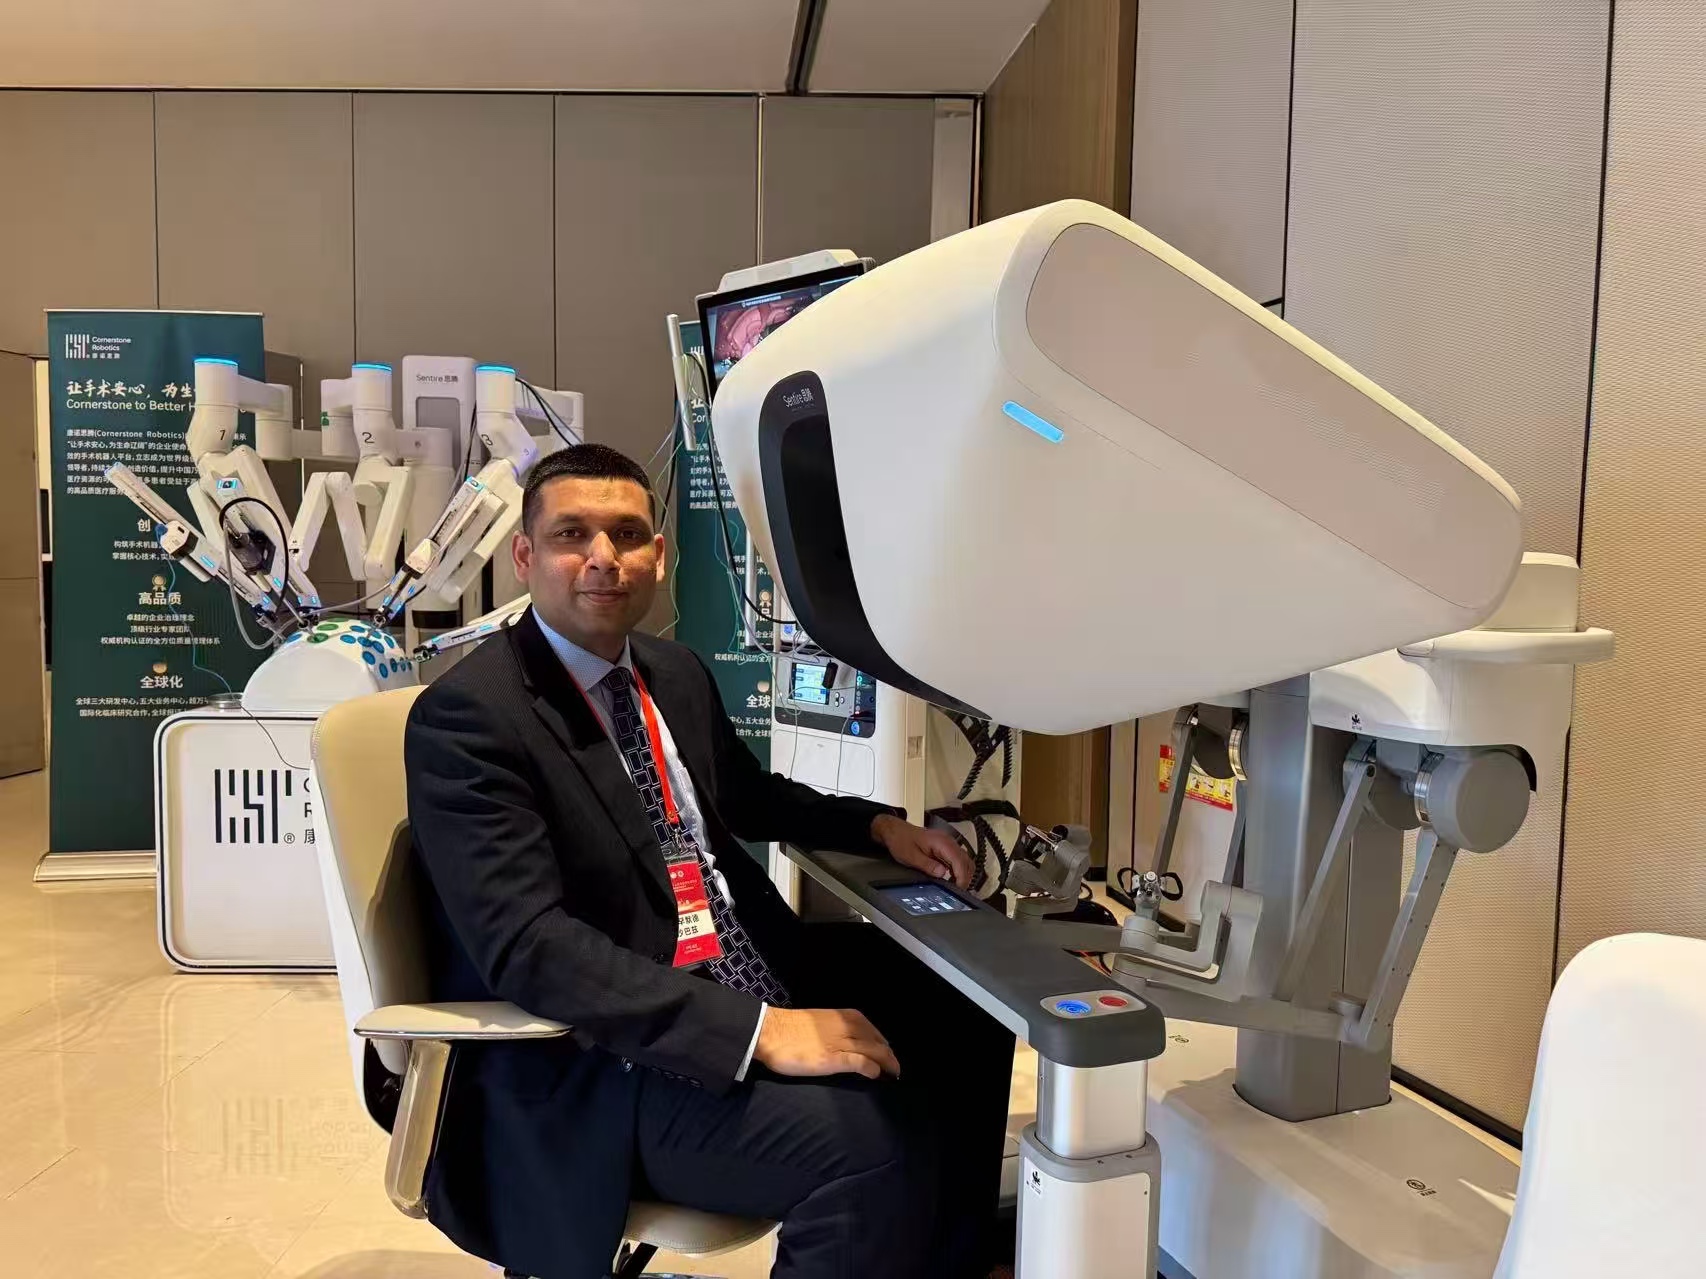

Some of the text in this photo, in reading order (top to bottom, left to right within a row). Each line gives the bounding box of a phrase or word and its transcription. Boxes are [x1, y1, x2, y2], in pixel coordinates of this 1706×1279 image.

[92, 336, 131, 344] Cornerstone
[66, 379, 197, 398] 让手术安心，为生
[66, 399, 132, 410] Cornerstone
[135, 401, 146, 410] to
[150, 400, 185, 412] Better
[362, 431, 375, 444] 2
[138, 592, 182, 605] 高品质
[140, 675, 184, 689] 全球化
